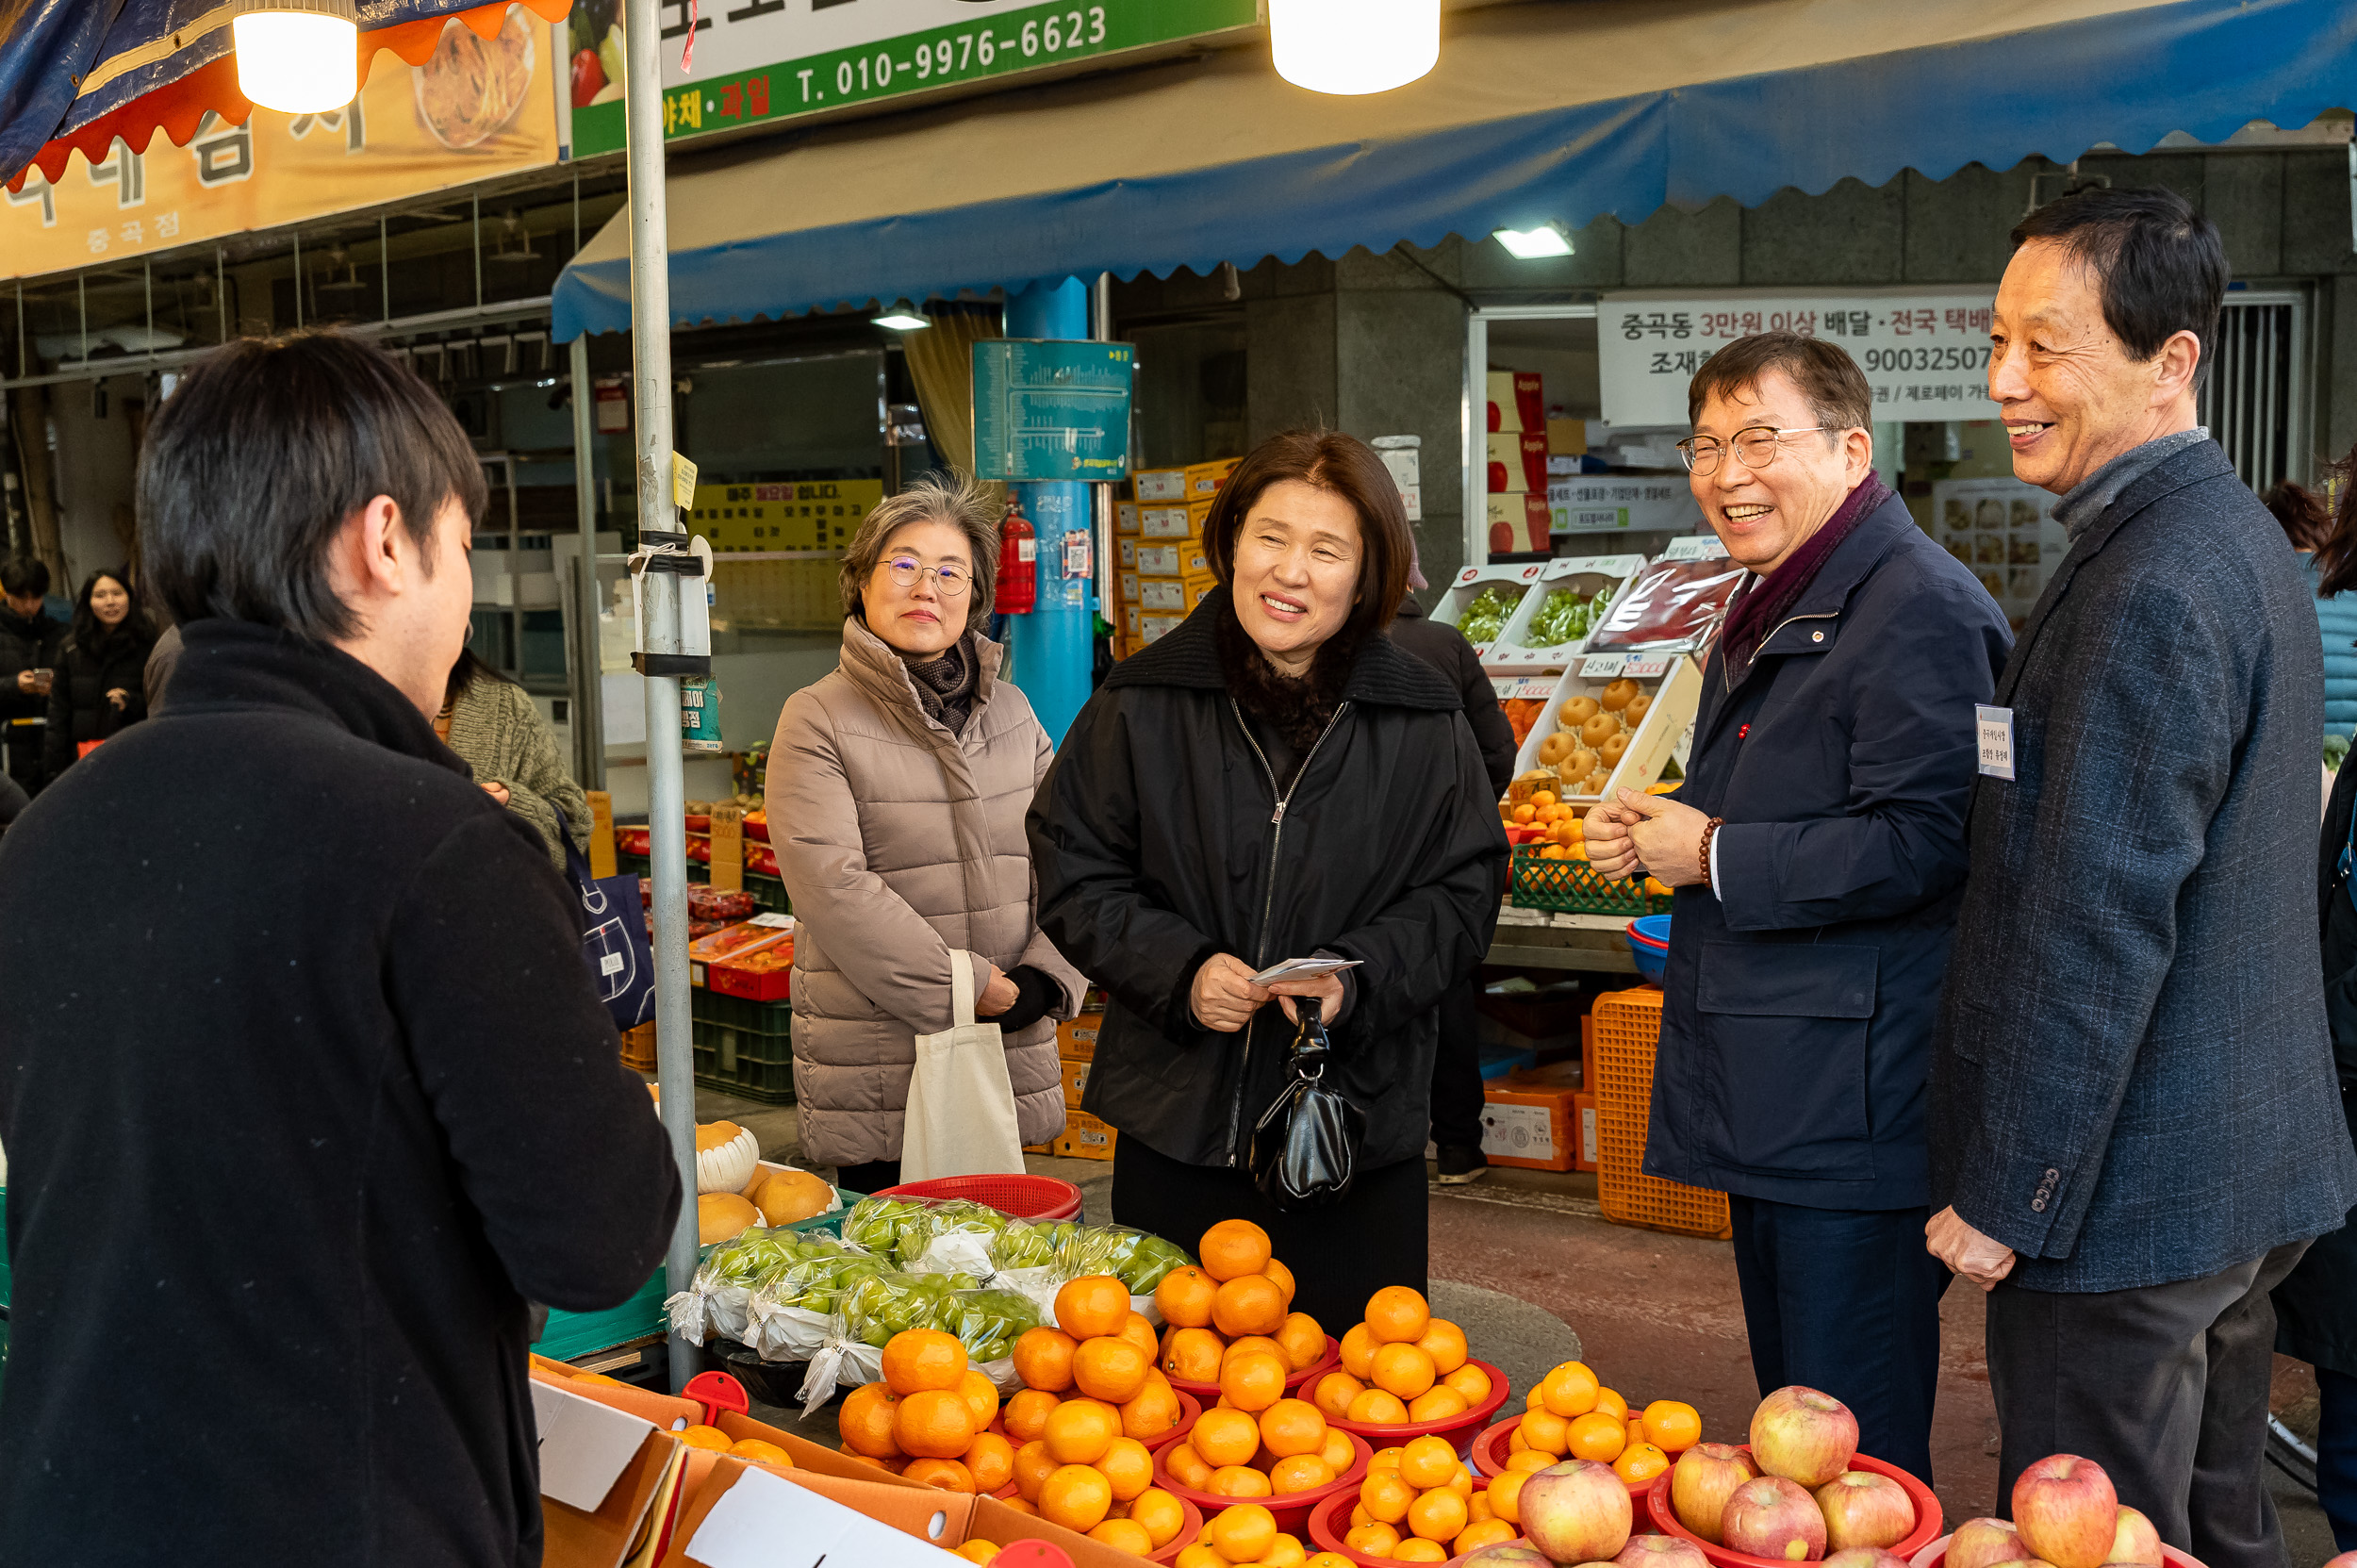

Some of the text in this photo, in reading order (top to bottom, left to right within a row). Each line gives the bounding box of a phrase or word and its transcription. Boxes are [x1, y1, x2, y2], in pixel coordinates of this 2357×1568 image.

[797, 69, 824, 103] T.
[836, 6, 1106, 95] 010-9976-6623
[1621, 312, 1693, 340] 중곡동
[1700, 311, 1762, 338] 3만원
[1770, 310, 1818, 337] 이상
[1824, 310, 1872, 337] 배달
[1890, 308, 1939, 336] 전국
[1945, 307, 1994, 335] 택배
[1904, 384, 1963, 402] 제로페이
[1524, 439, 1544, 452] Apple
